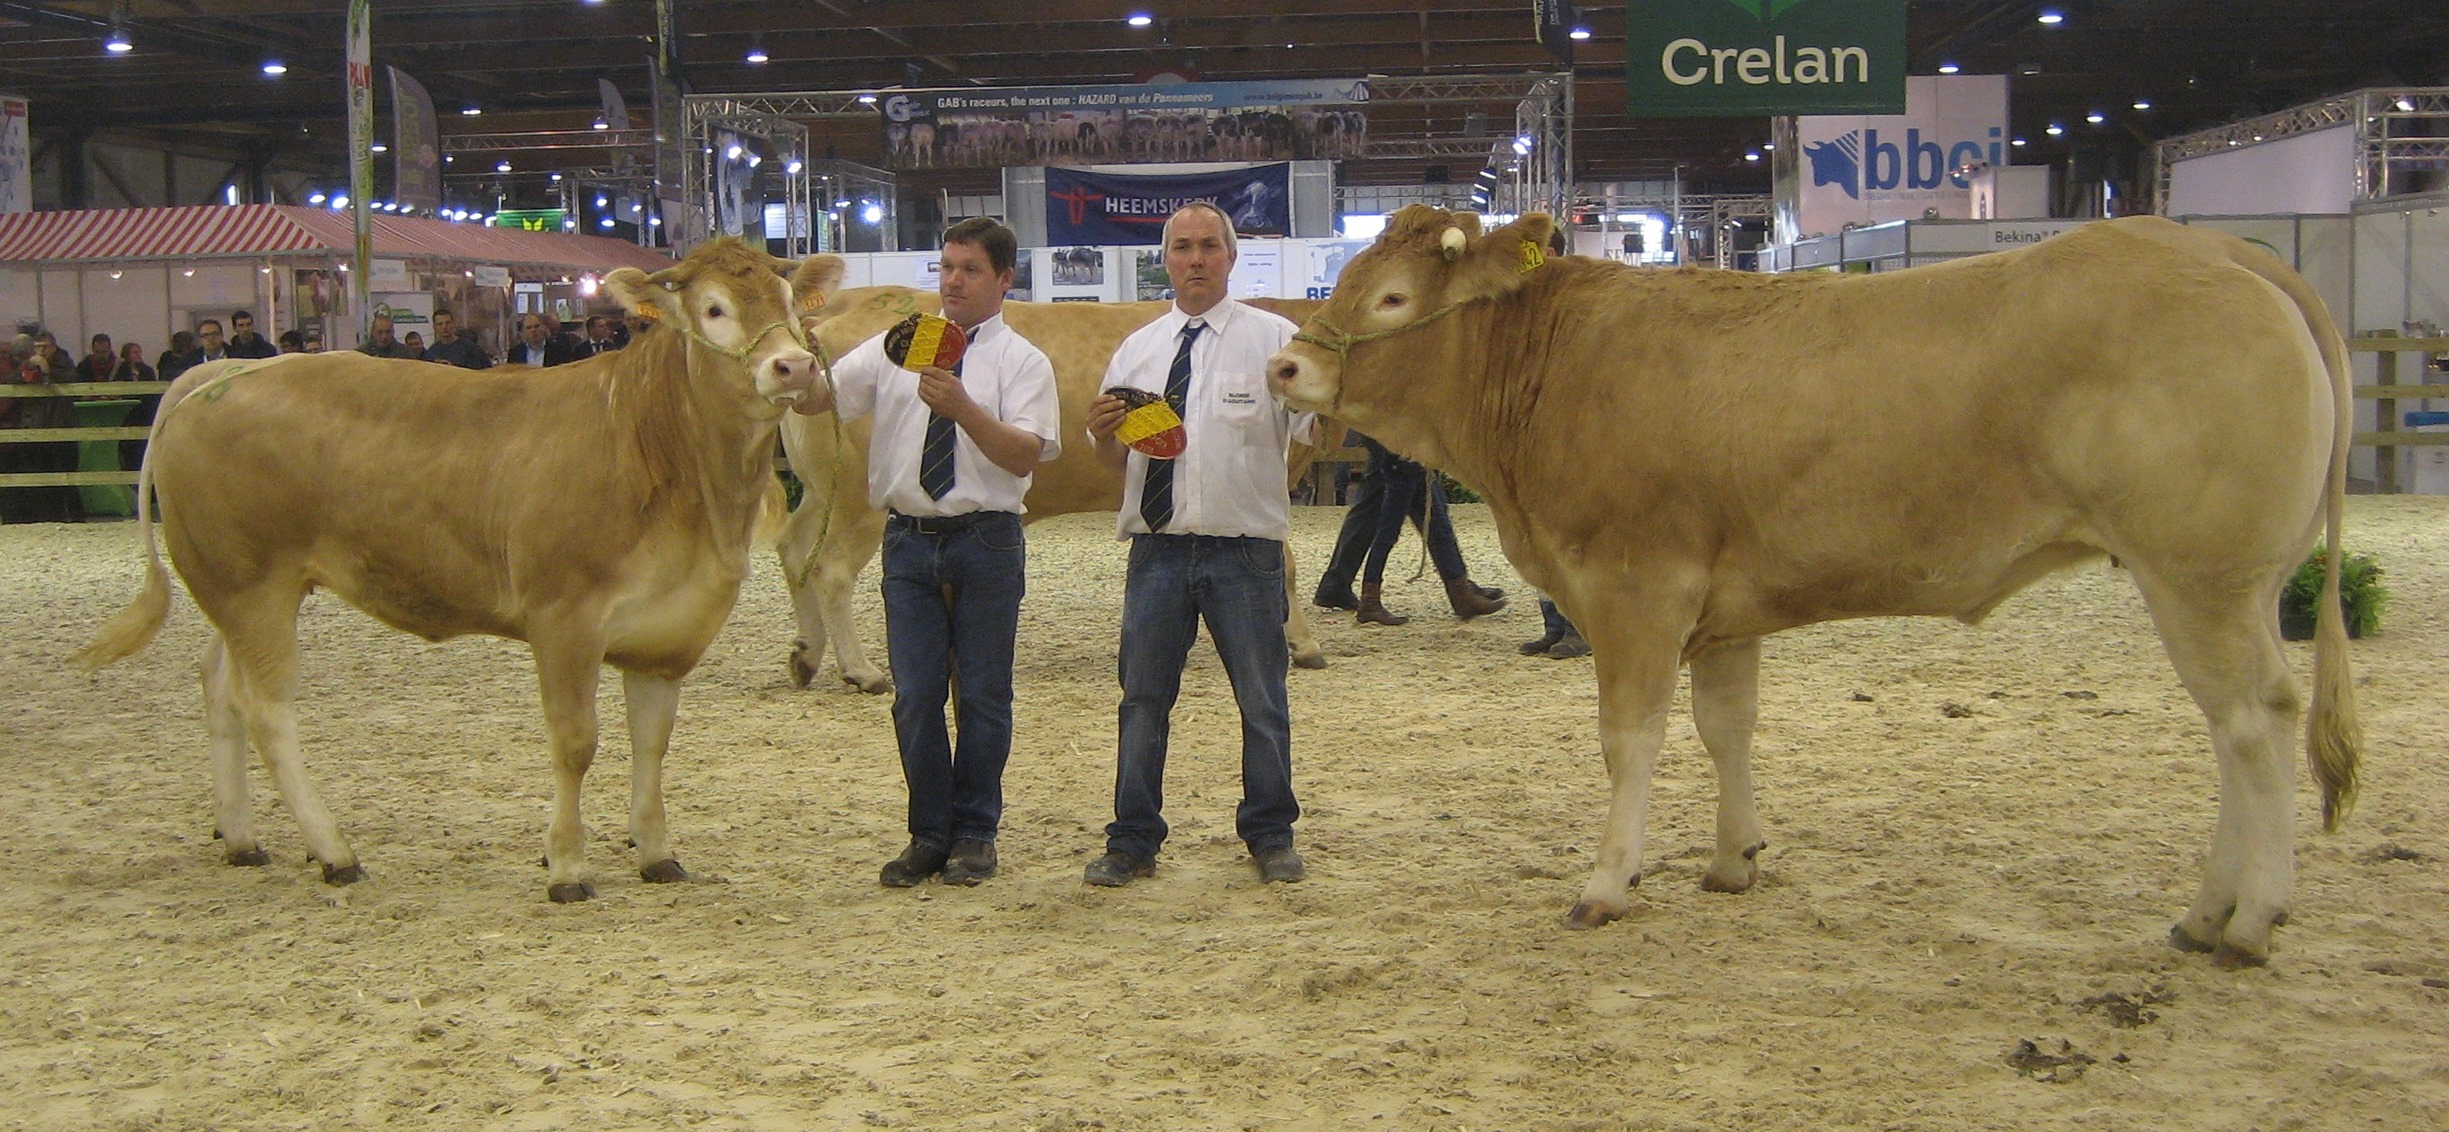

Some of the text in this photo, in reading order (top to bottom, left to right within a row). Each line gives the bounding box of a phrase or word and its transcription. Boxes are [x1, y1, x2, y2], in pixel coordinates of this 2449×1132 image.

[1661, 35, 1869, 86] Crelan
[1010, 96, 1027, 106] the
[1028, 97, 1051, 106] next
[1078, 94, 1117, 105] HAZARD
[1119, 96, 1136, 104] van
[1138, 93, 1151, 104] de
[1864, 127, 2002, 191] bbci
